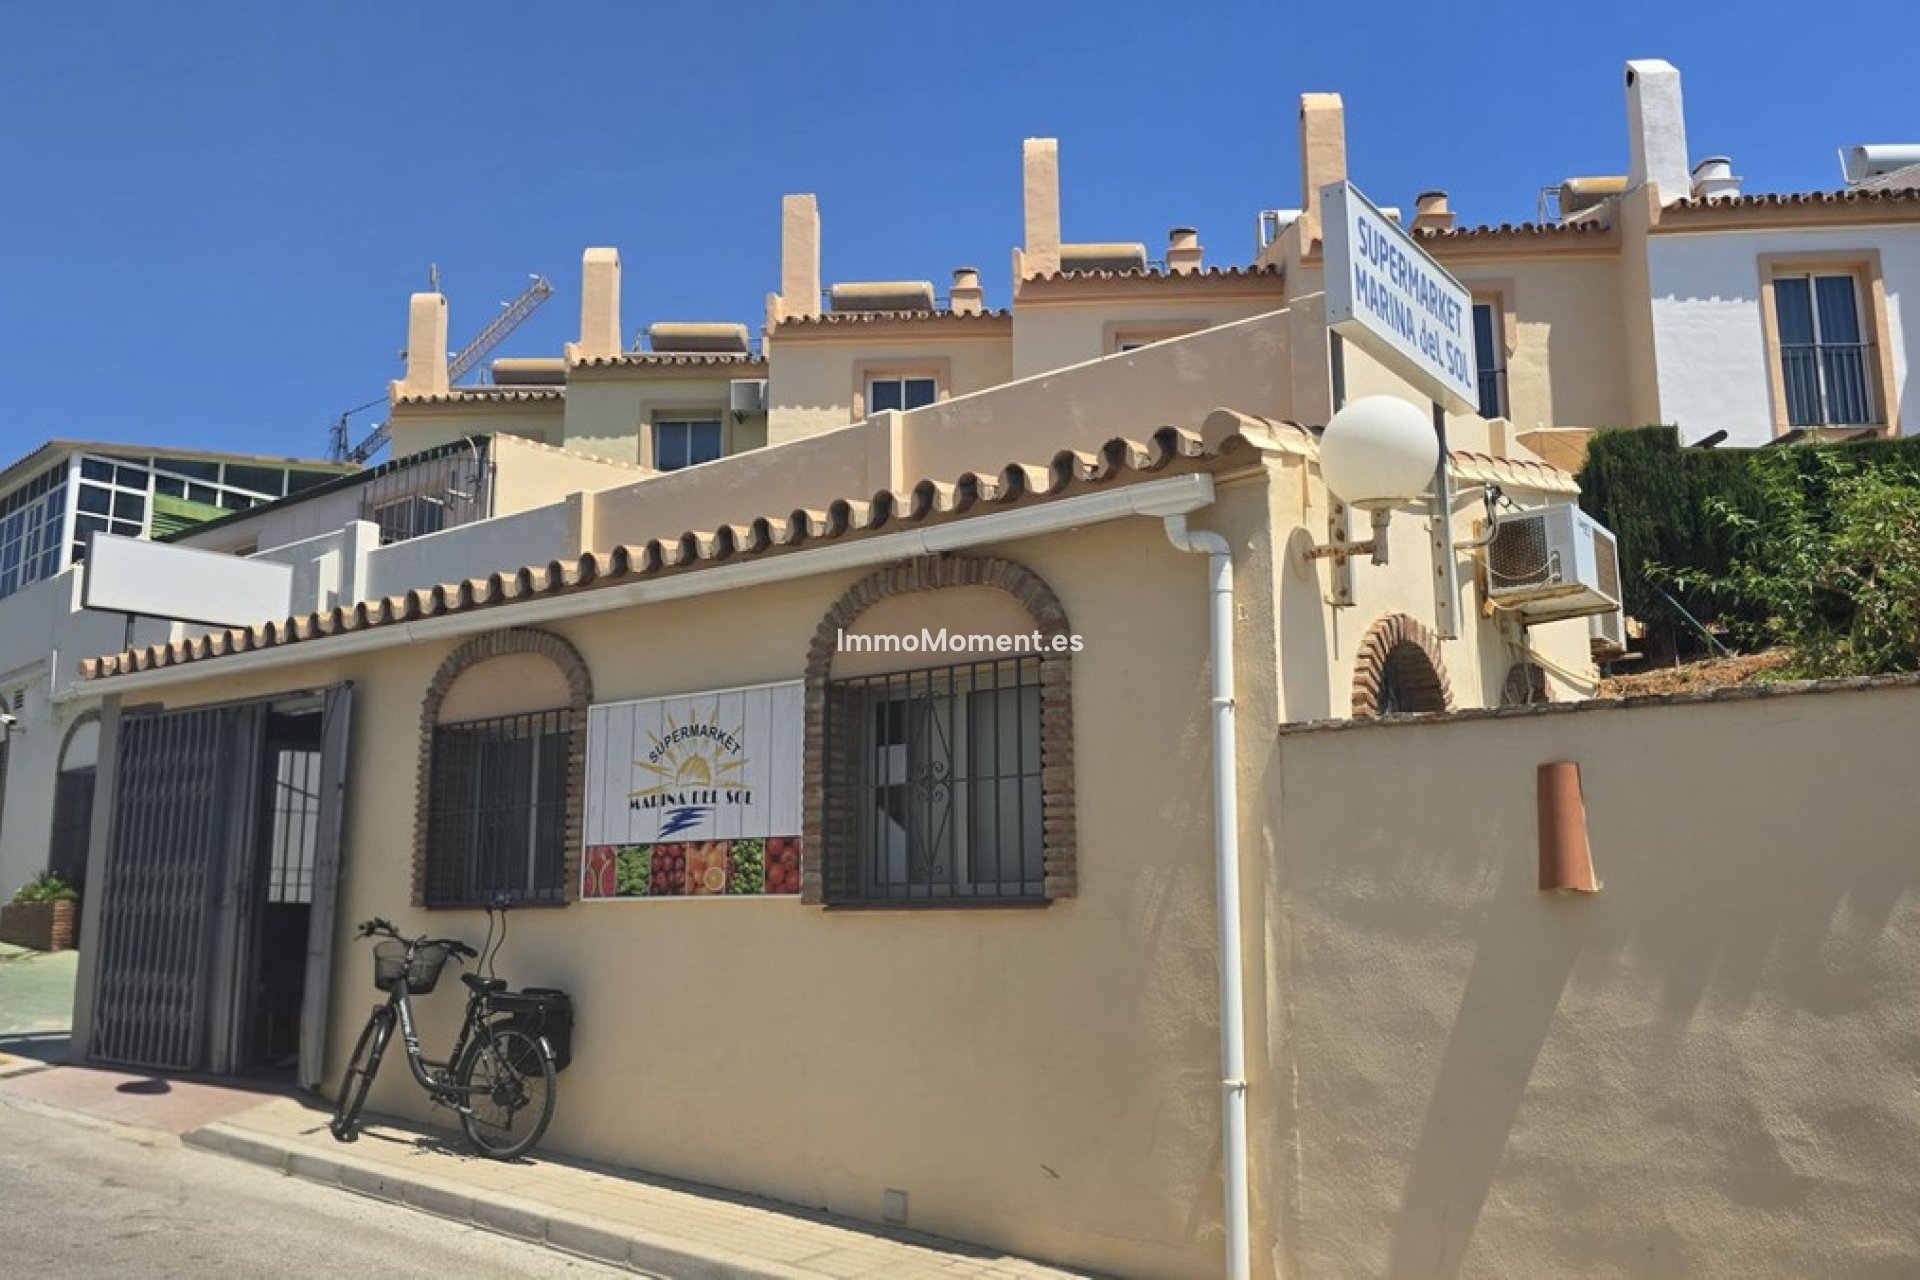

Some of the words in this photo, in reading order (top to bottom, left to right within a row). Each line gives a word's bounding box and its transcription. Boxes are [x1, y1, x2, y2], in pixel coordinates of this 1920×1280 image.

[1357, 216, 1462, 337] SUPERMARKET
[1355, 262, 1417, 347] MARINA
[1447, 340, 1472, 388] SOL
[649, 724, 741, 763] SUPERMARKET
[631, 793, 686, 810] MARINA
[692, 790, 717, 805] DEL
[726, 790, 752, 805] SOL
